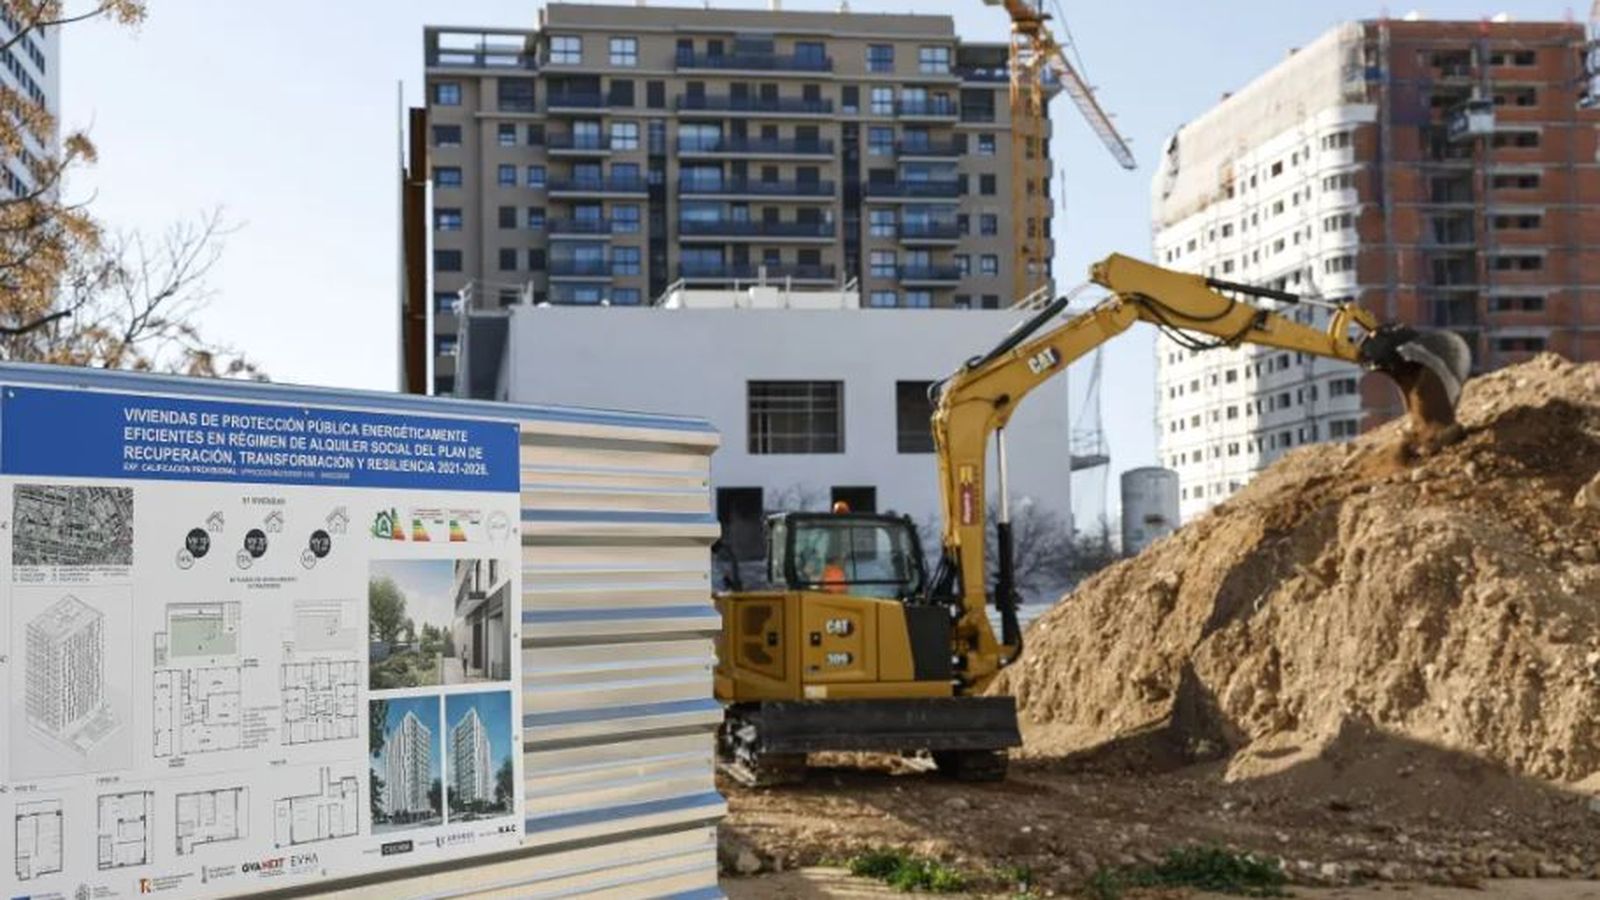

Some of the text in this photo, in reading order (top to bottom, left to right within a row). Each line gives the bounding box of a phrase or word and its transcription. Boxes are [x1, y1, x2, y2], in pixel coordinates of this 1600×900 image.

[1028, 347, 1056, 374] CAT
[124, 408, 468, 442] VIVIENDAS DE PROTECCIÓN PÚBLICA ENERGÉTICAMENTE
[124, 427, 483, 459] EFICIENTES EN RÉGIMEN DE ALQUILER SOCIAL DEL PLAN DE
[124, 446, 236, 465] RECUPERACIÓN,
[240, 451, 355, 469] TRANSFORMACIÓN
[357, 457, 365, 469] Y
[367, 458, 435, 473] RESILIENCIA
[826, 619, 848, 634] CAT
